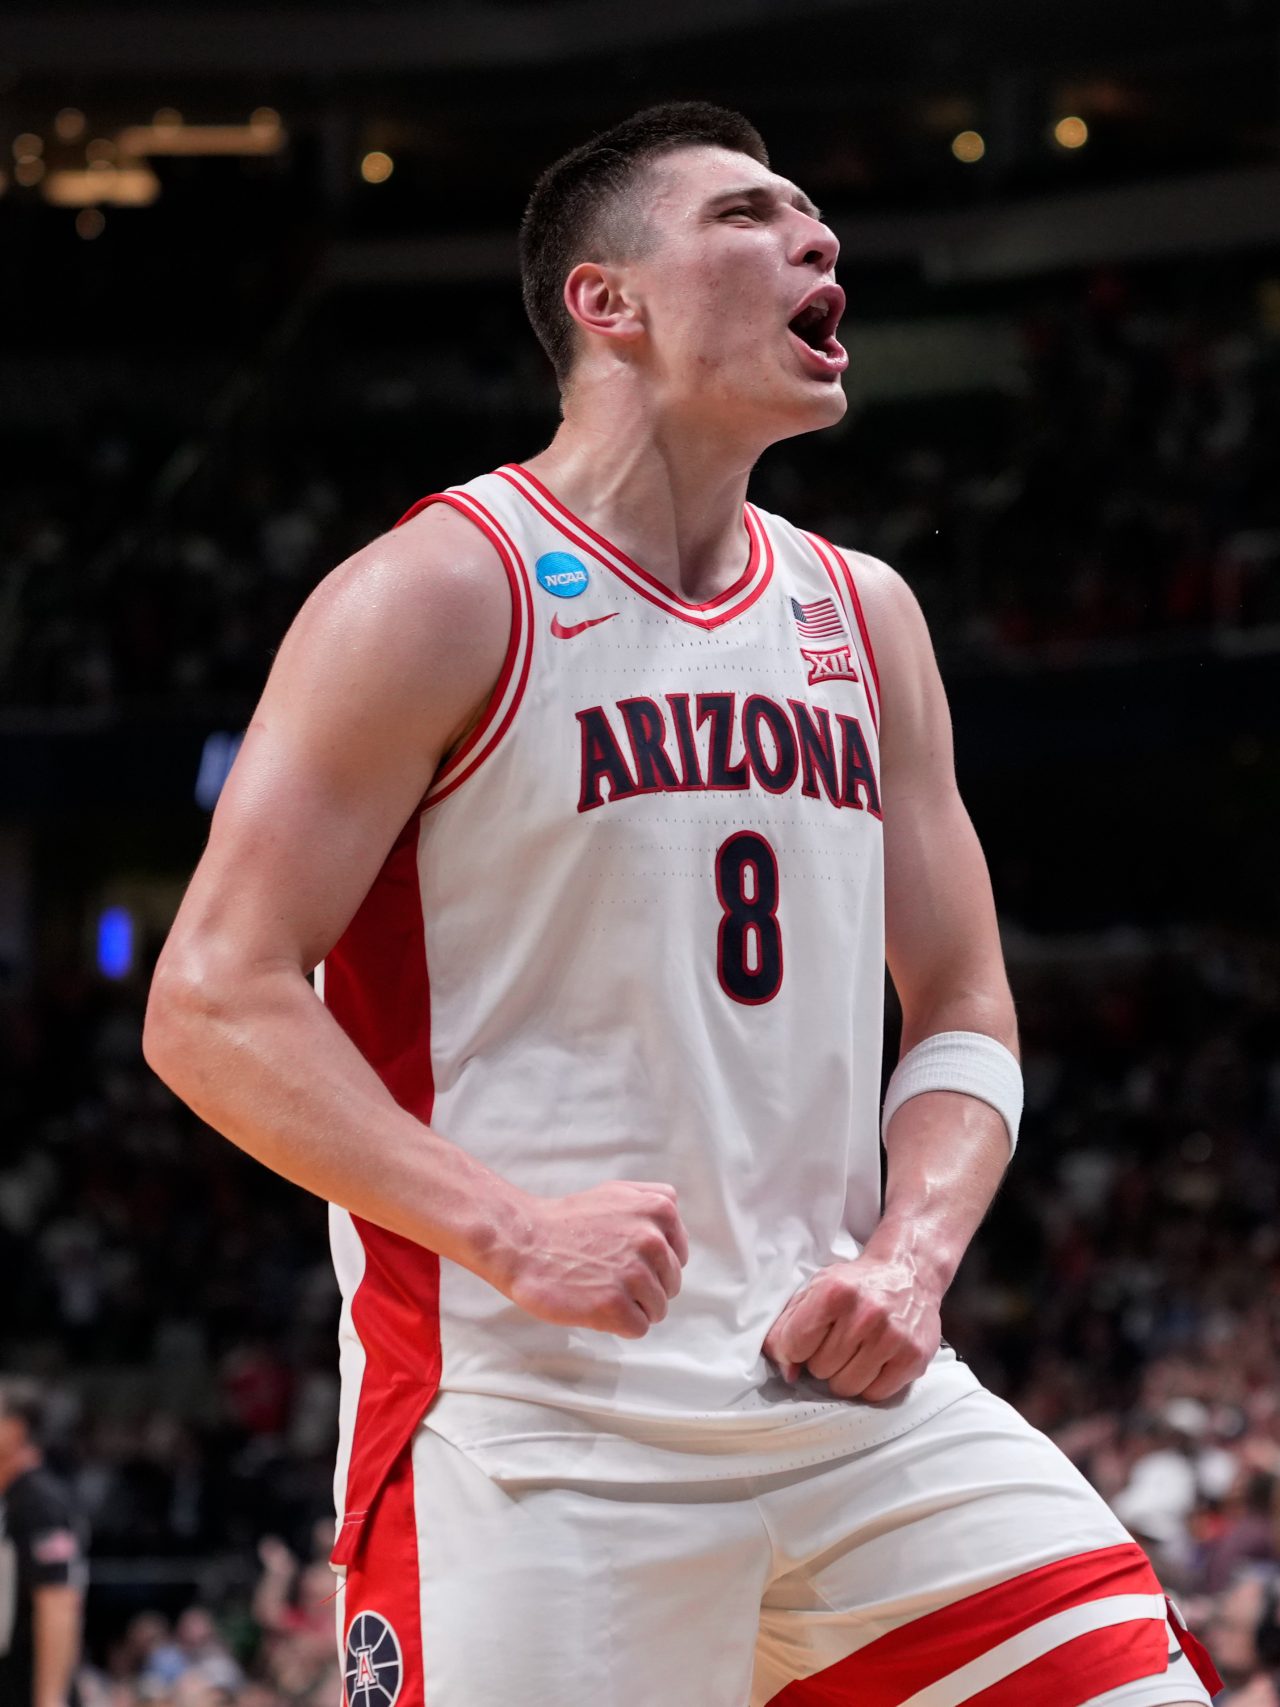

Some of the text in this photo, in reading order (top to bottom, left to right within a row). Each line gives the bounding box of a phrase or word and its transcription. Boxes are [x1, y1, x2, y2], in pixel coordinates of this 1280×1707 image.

[544, 571, 588, 587] NCAA
[575, 692, 883, 822] ARIZONA
[715, 829, 784, 1006] 8
[355, 1647, 378, 1690] A
